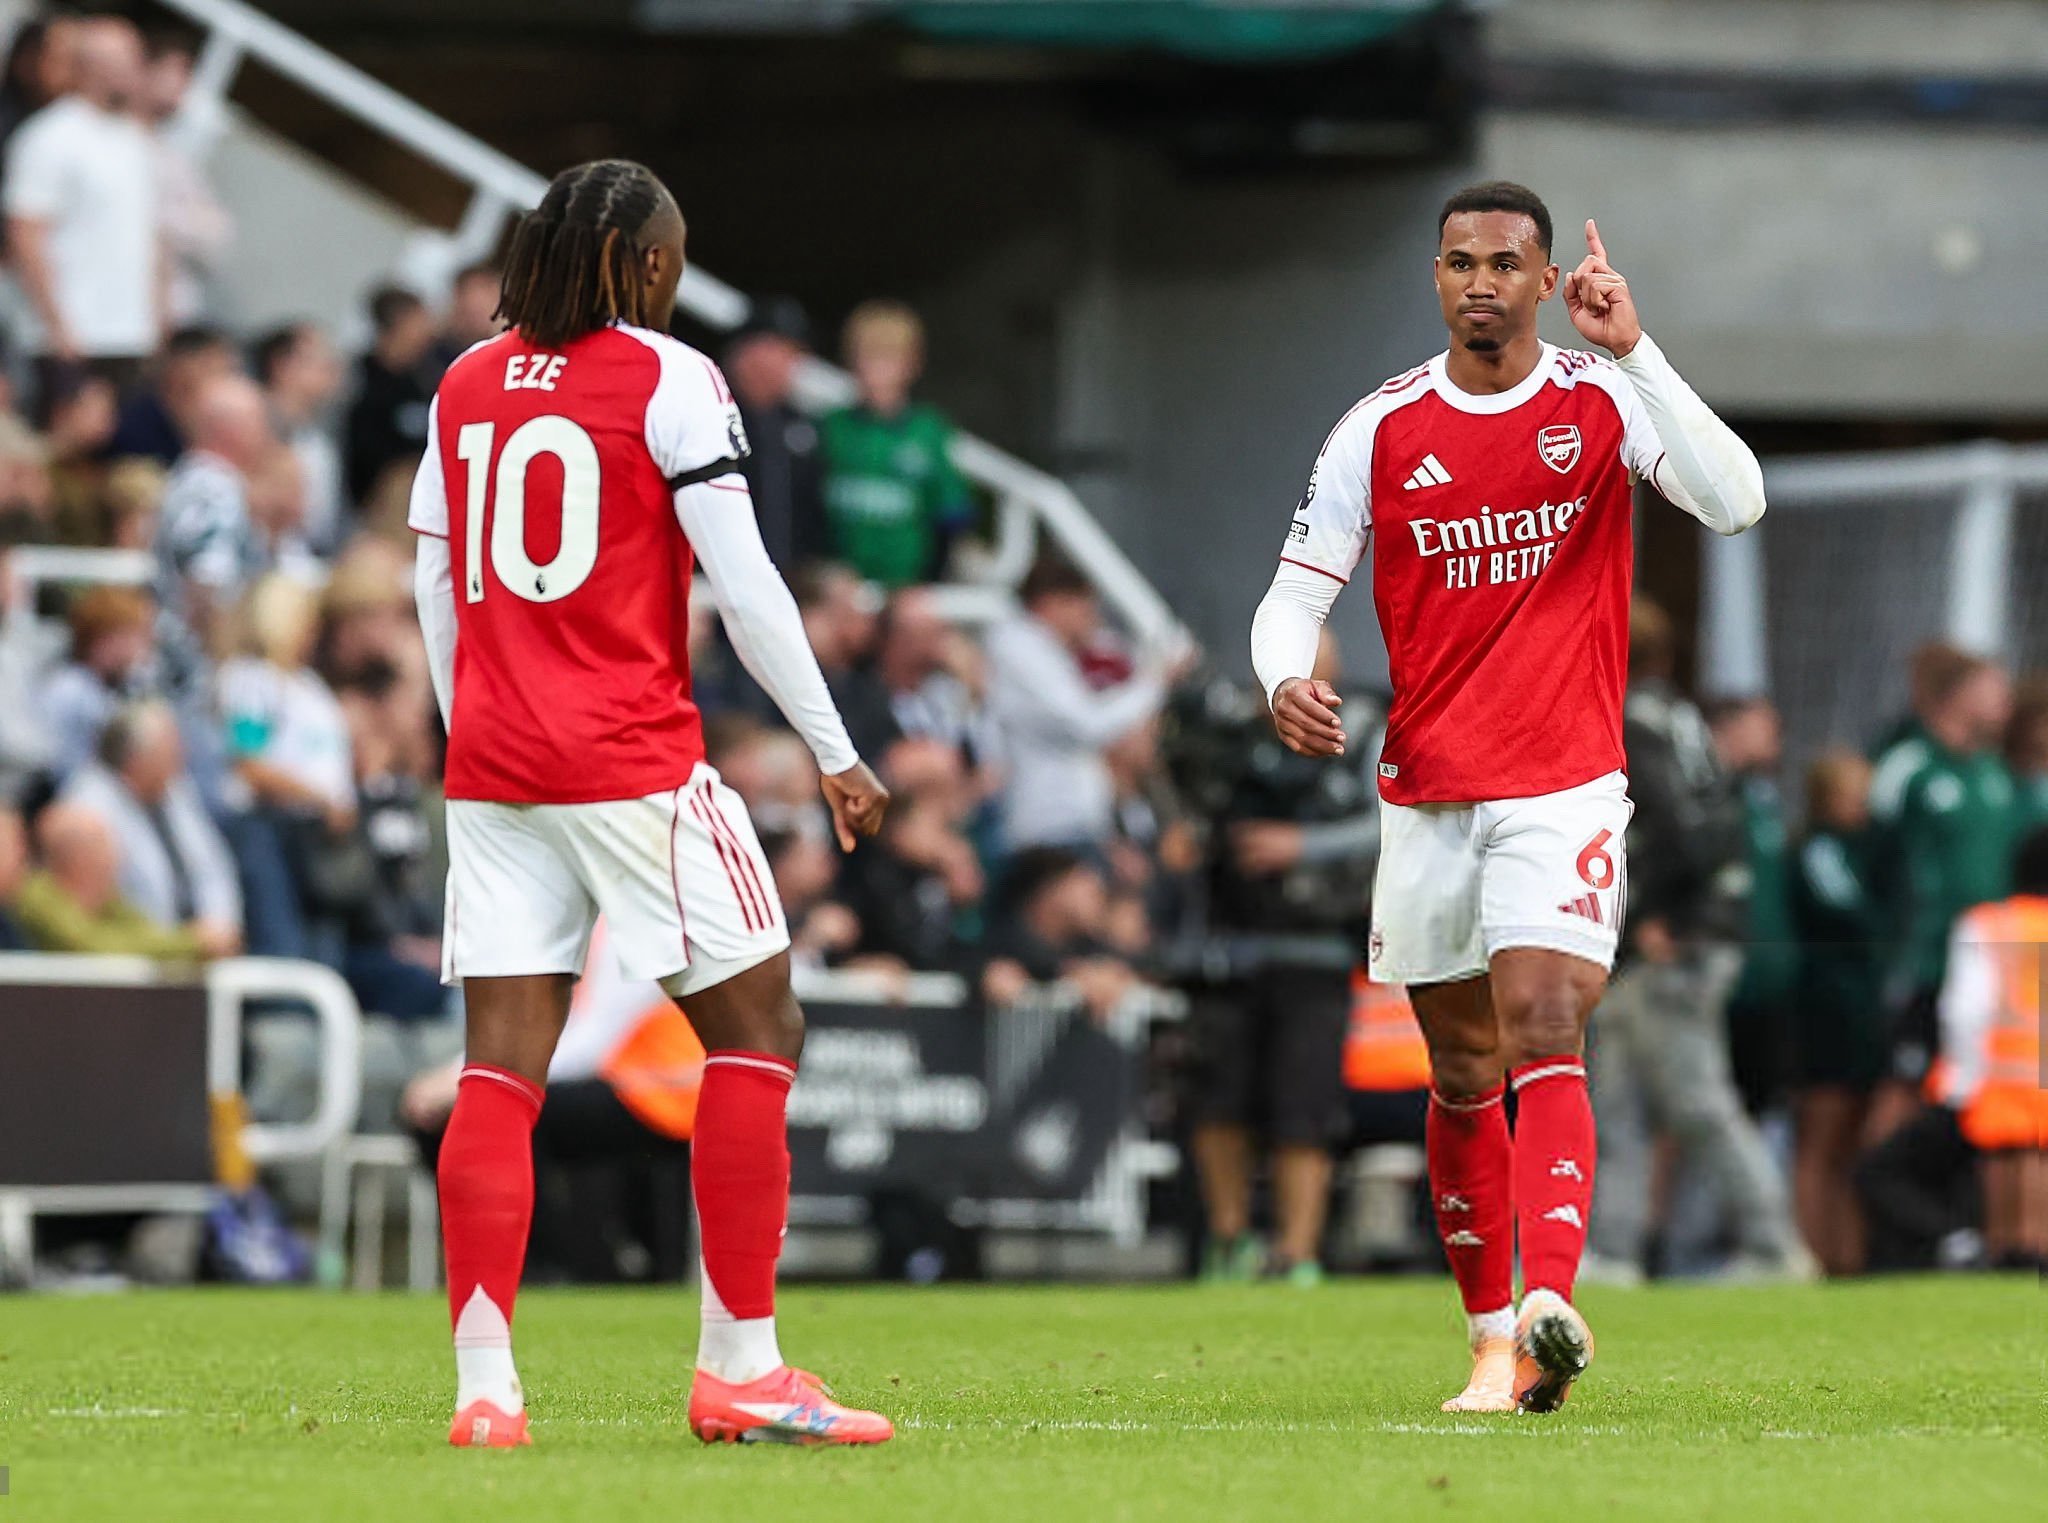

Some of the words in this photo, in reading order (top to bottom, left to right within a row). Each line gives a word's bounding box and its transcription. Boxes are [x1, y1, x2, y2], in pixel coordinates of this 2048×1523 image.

[503, 354, 568, 392] EZE
[1543, 431, 1575, 444] Arsenal
[457, 414, 601, 604] 10
[1446, 555, 1481, 590] FLY
[1490, 539, 1564, 585] BETTE
[1576, 828, 1614, 890] 6
